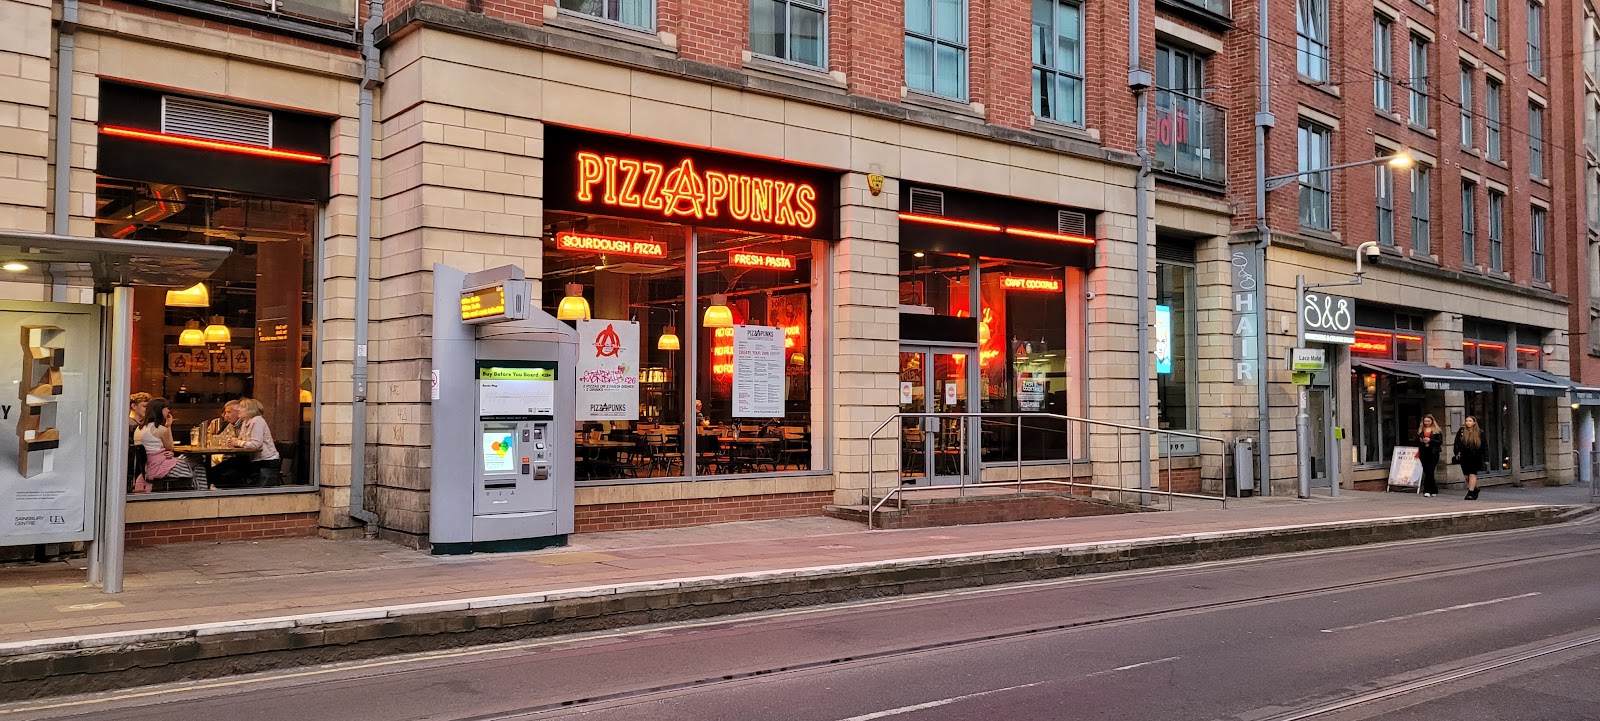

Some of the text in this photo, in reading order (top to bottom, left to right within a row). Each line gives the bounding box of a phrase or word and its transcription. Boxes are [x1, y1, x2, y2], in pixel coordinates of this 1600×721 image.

[562, 235, 662, 256] SOURDOUGH PIZZA
[734, 253, 792, 268] FRESH PASTA
[1005, 278, 1059, 290] CRAFT COCKTAILS
[1304, 294, 1351, 331] S&B
[715, 327, 734, 337] NO GO
[1235, 293, 1253, 380] HAIR
[714, 347, 723, 356] NO
[713, 365, 723, 374] NO
